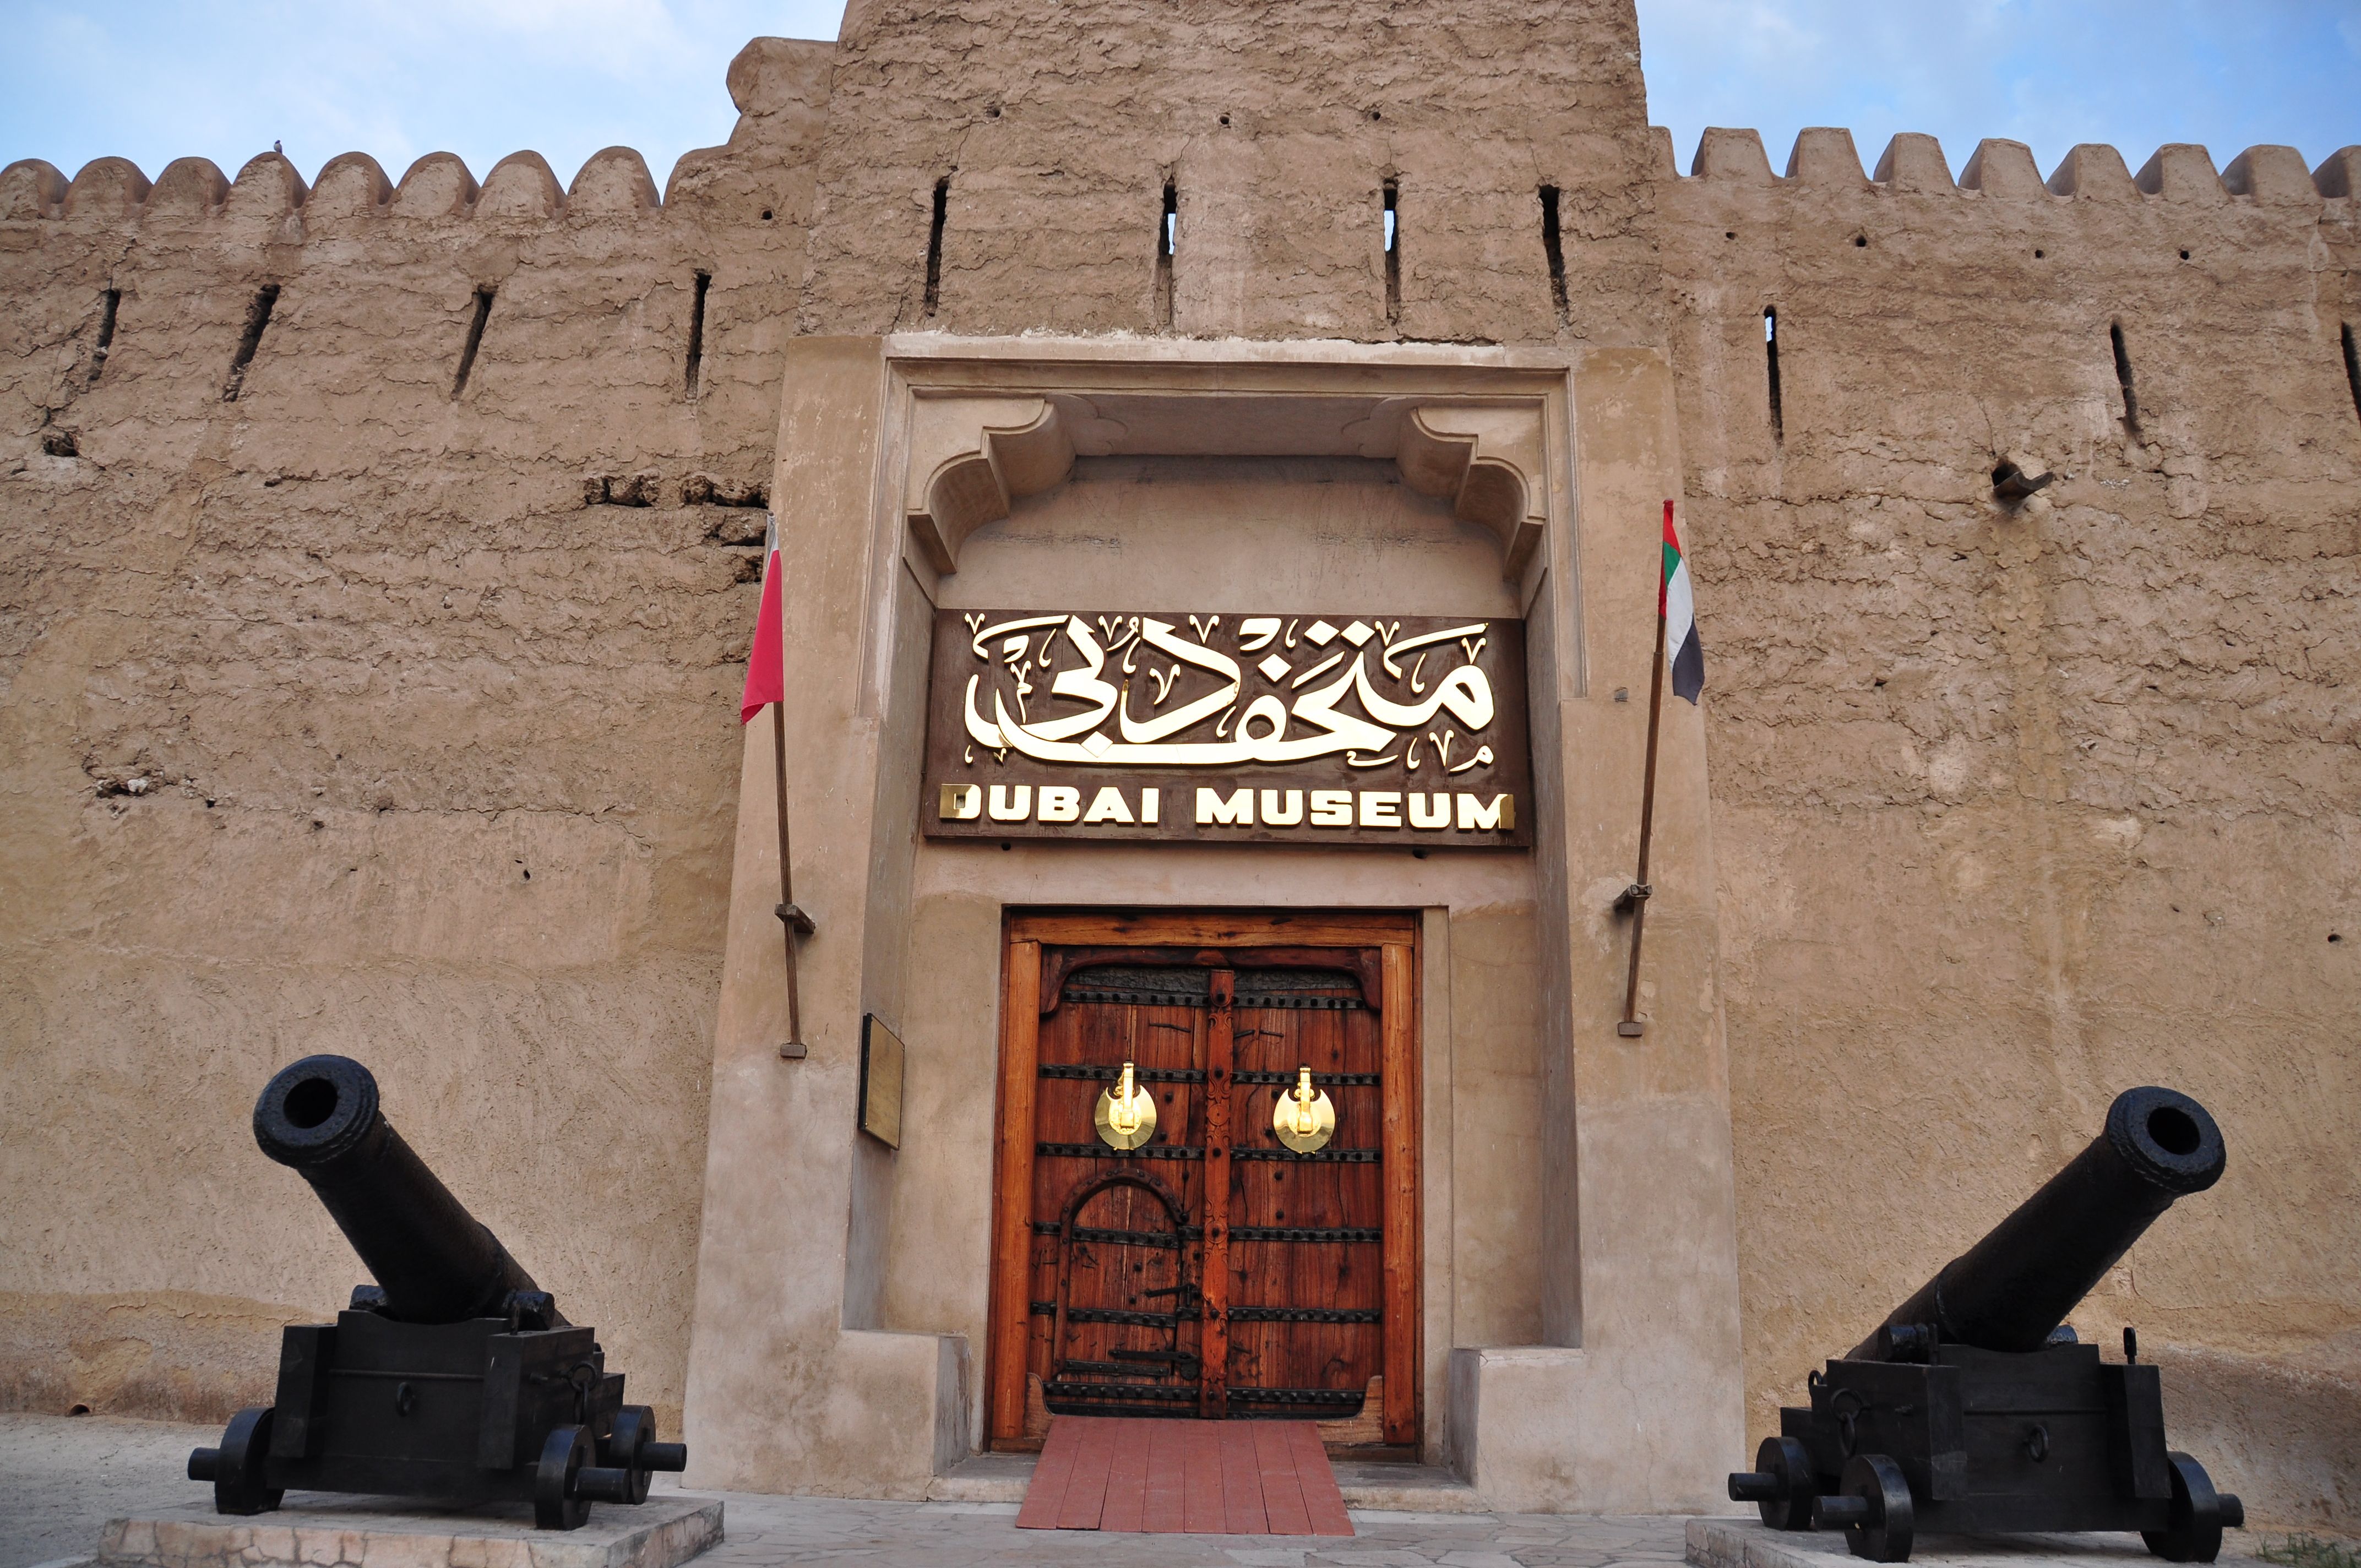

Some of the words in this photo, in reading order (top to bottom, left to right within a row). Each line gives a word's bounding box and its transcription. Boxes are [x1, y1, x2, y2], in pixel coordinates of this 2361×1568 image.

[995, 619, 1494, 765] متحف
[939, 783, 1160, 823] DUBAI
[1195, 787, 1515, 830] MUSEUM
